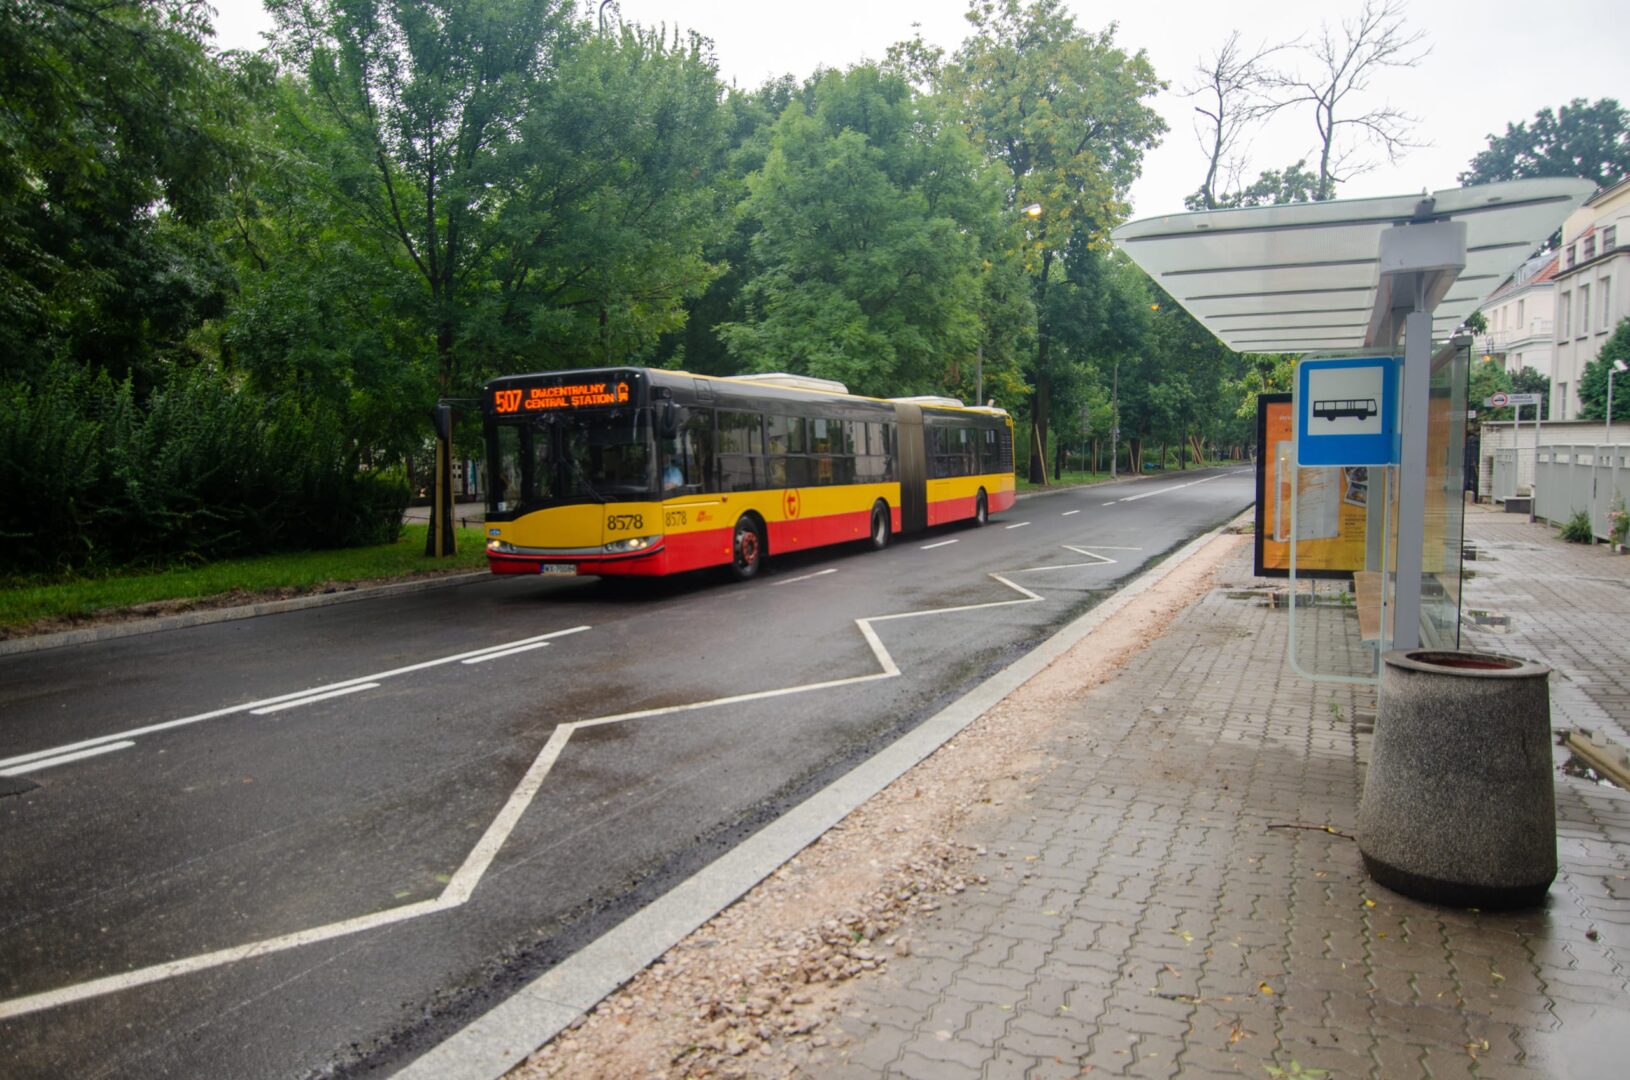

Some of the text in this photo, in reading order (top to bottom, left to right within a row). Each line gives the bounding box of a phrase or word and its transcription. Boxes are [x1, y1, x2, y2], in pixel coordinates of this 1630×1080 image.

[495, 389, 523, 413] 507
[525, 393, 615, 410] CENTRAL STATION
[607, 513, 644, 531] 8578
[665, 510, 687, 527] 8578
